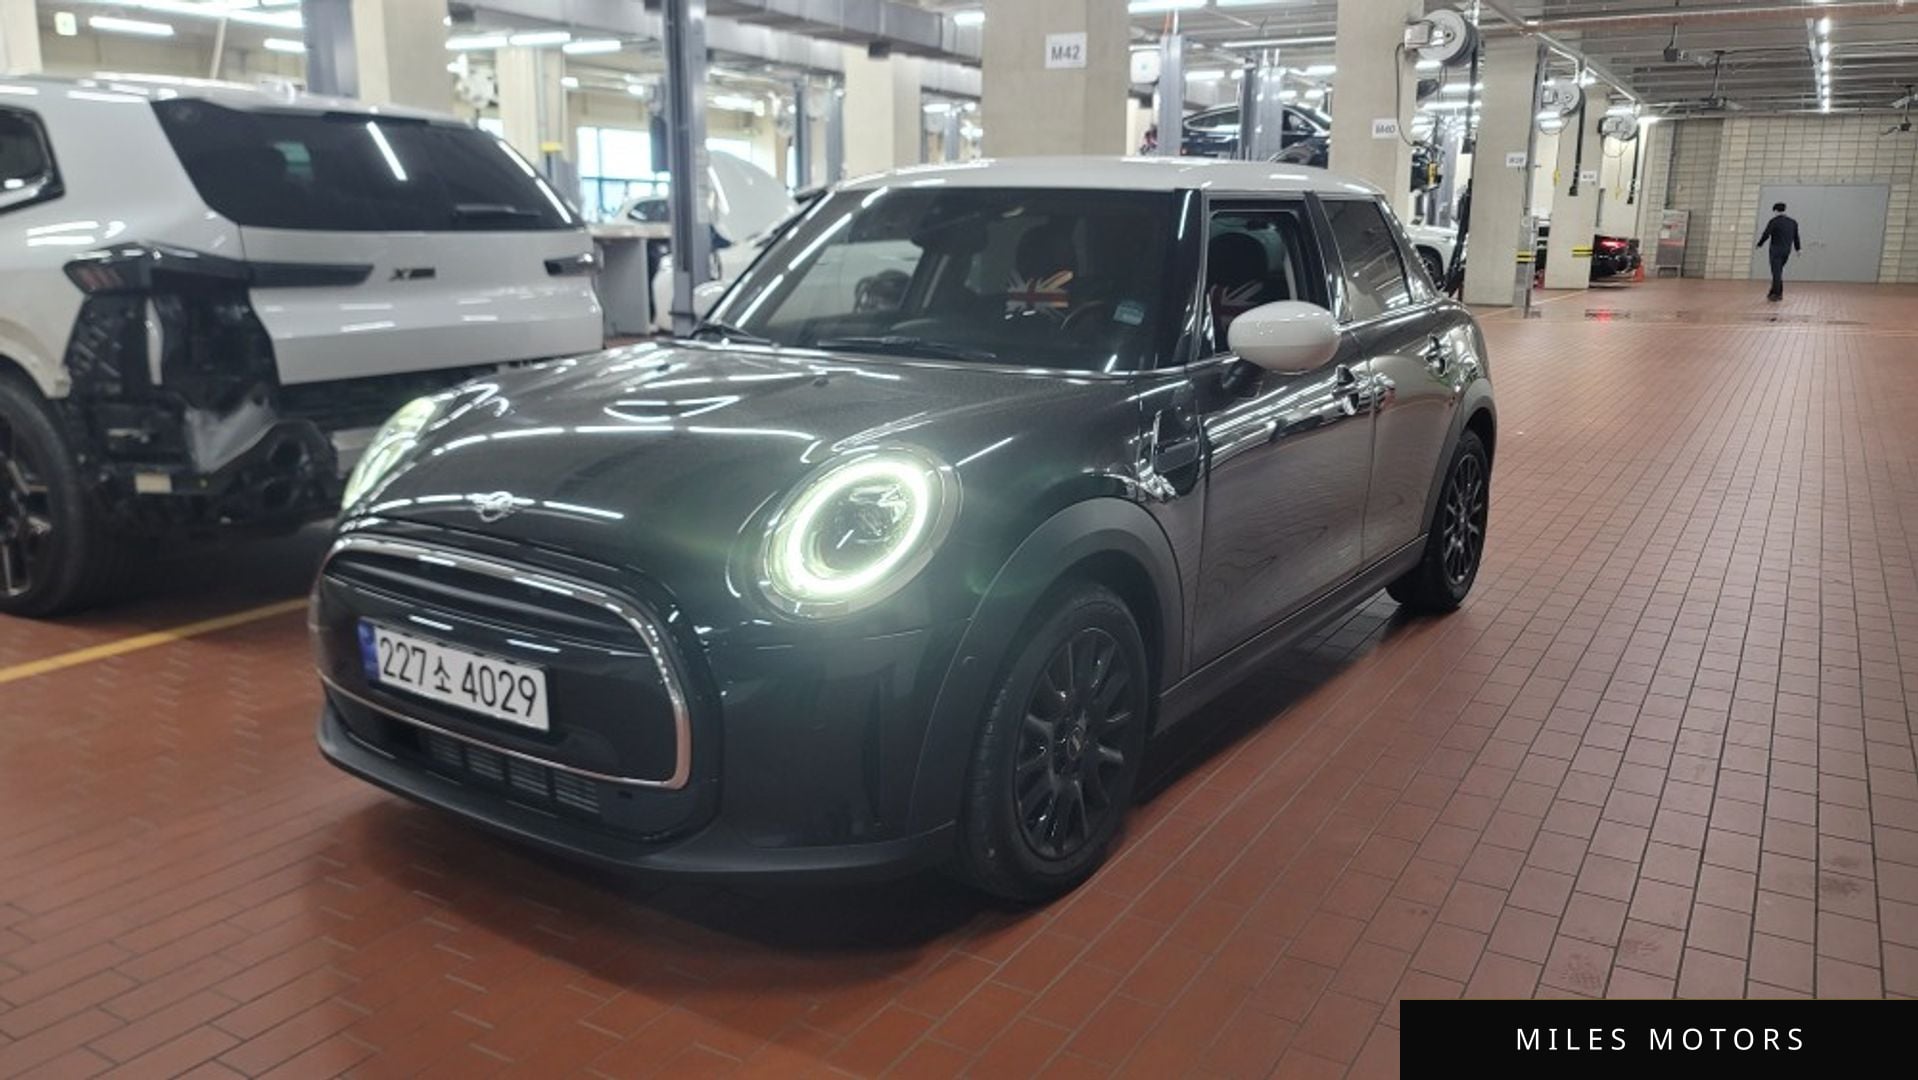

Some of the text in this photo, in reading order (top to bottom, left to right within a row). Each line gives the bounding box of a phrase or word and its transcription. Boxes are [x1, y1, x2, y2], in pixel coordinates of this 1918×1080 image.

[1051, 44, 1081, 61] M42
[380, 637, 537, 717] 227소 4029
